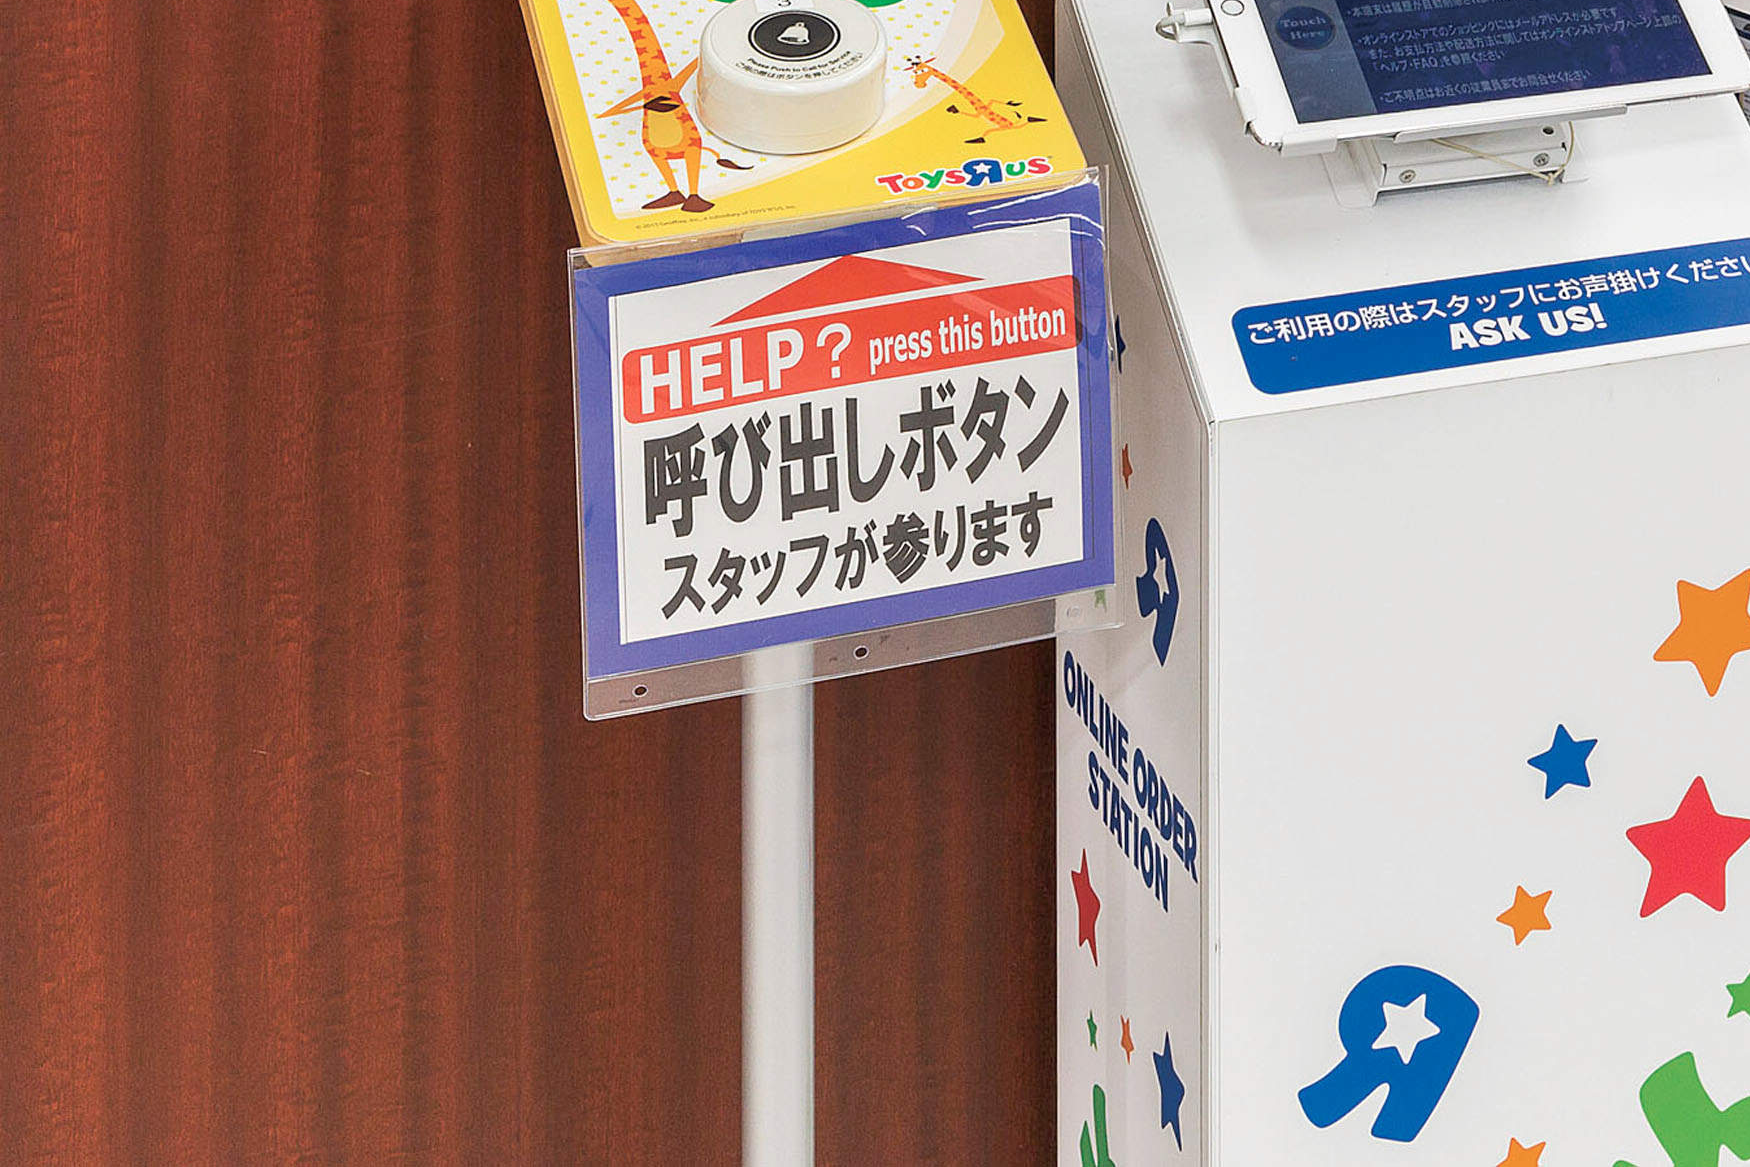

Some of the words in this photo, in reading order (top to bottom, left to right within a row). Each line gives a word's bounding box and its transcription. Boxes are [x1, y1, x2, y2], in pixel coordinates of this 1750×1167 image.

[1280, 16, 1326, 28] Touch
[1290, 30, 1325, 40] Here
[868, 326, 932, 374] press
[937, 314, 983, 352] this
[989, 305, 1067, 346] button
[1448, 313, 1530, 351] ASK
[1547, 303, 1608, 337] US!
[643, 375, 1069, 537] 呼び出しボタン
[661, 491, 1054, 619] スタッフが参ります
[1063, 650, 1129, 785] ONLINE
[1133, 747, 1198, 884] ORDER
[1088, 750, 1168, 913] STATION
